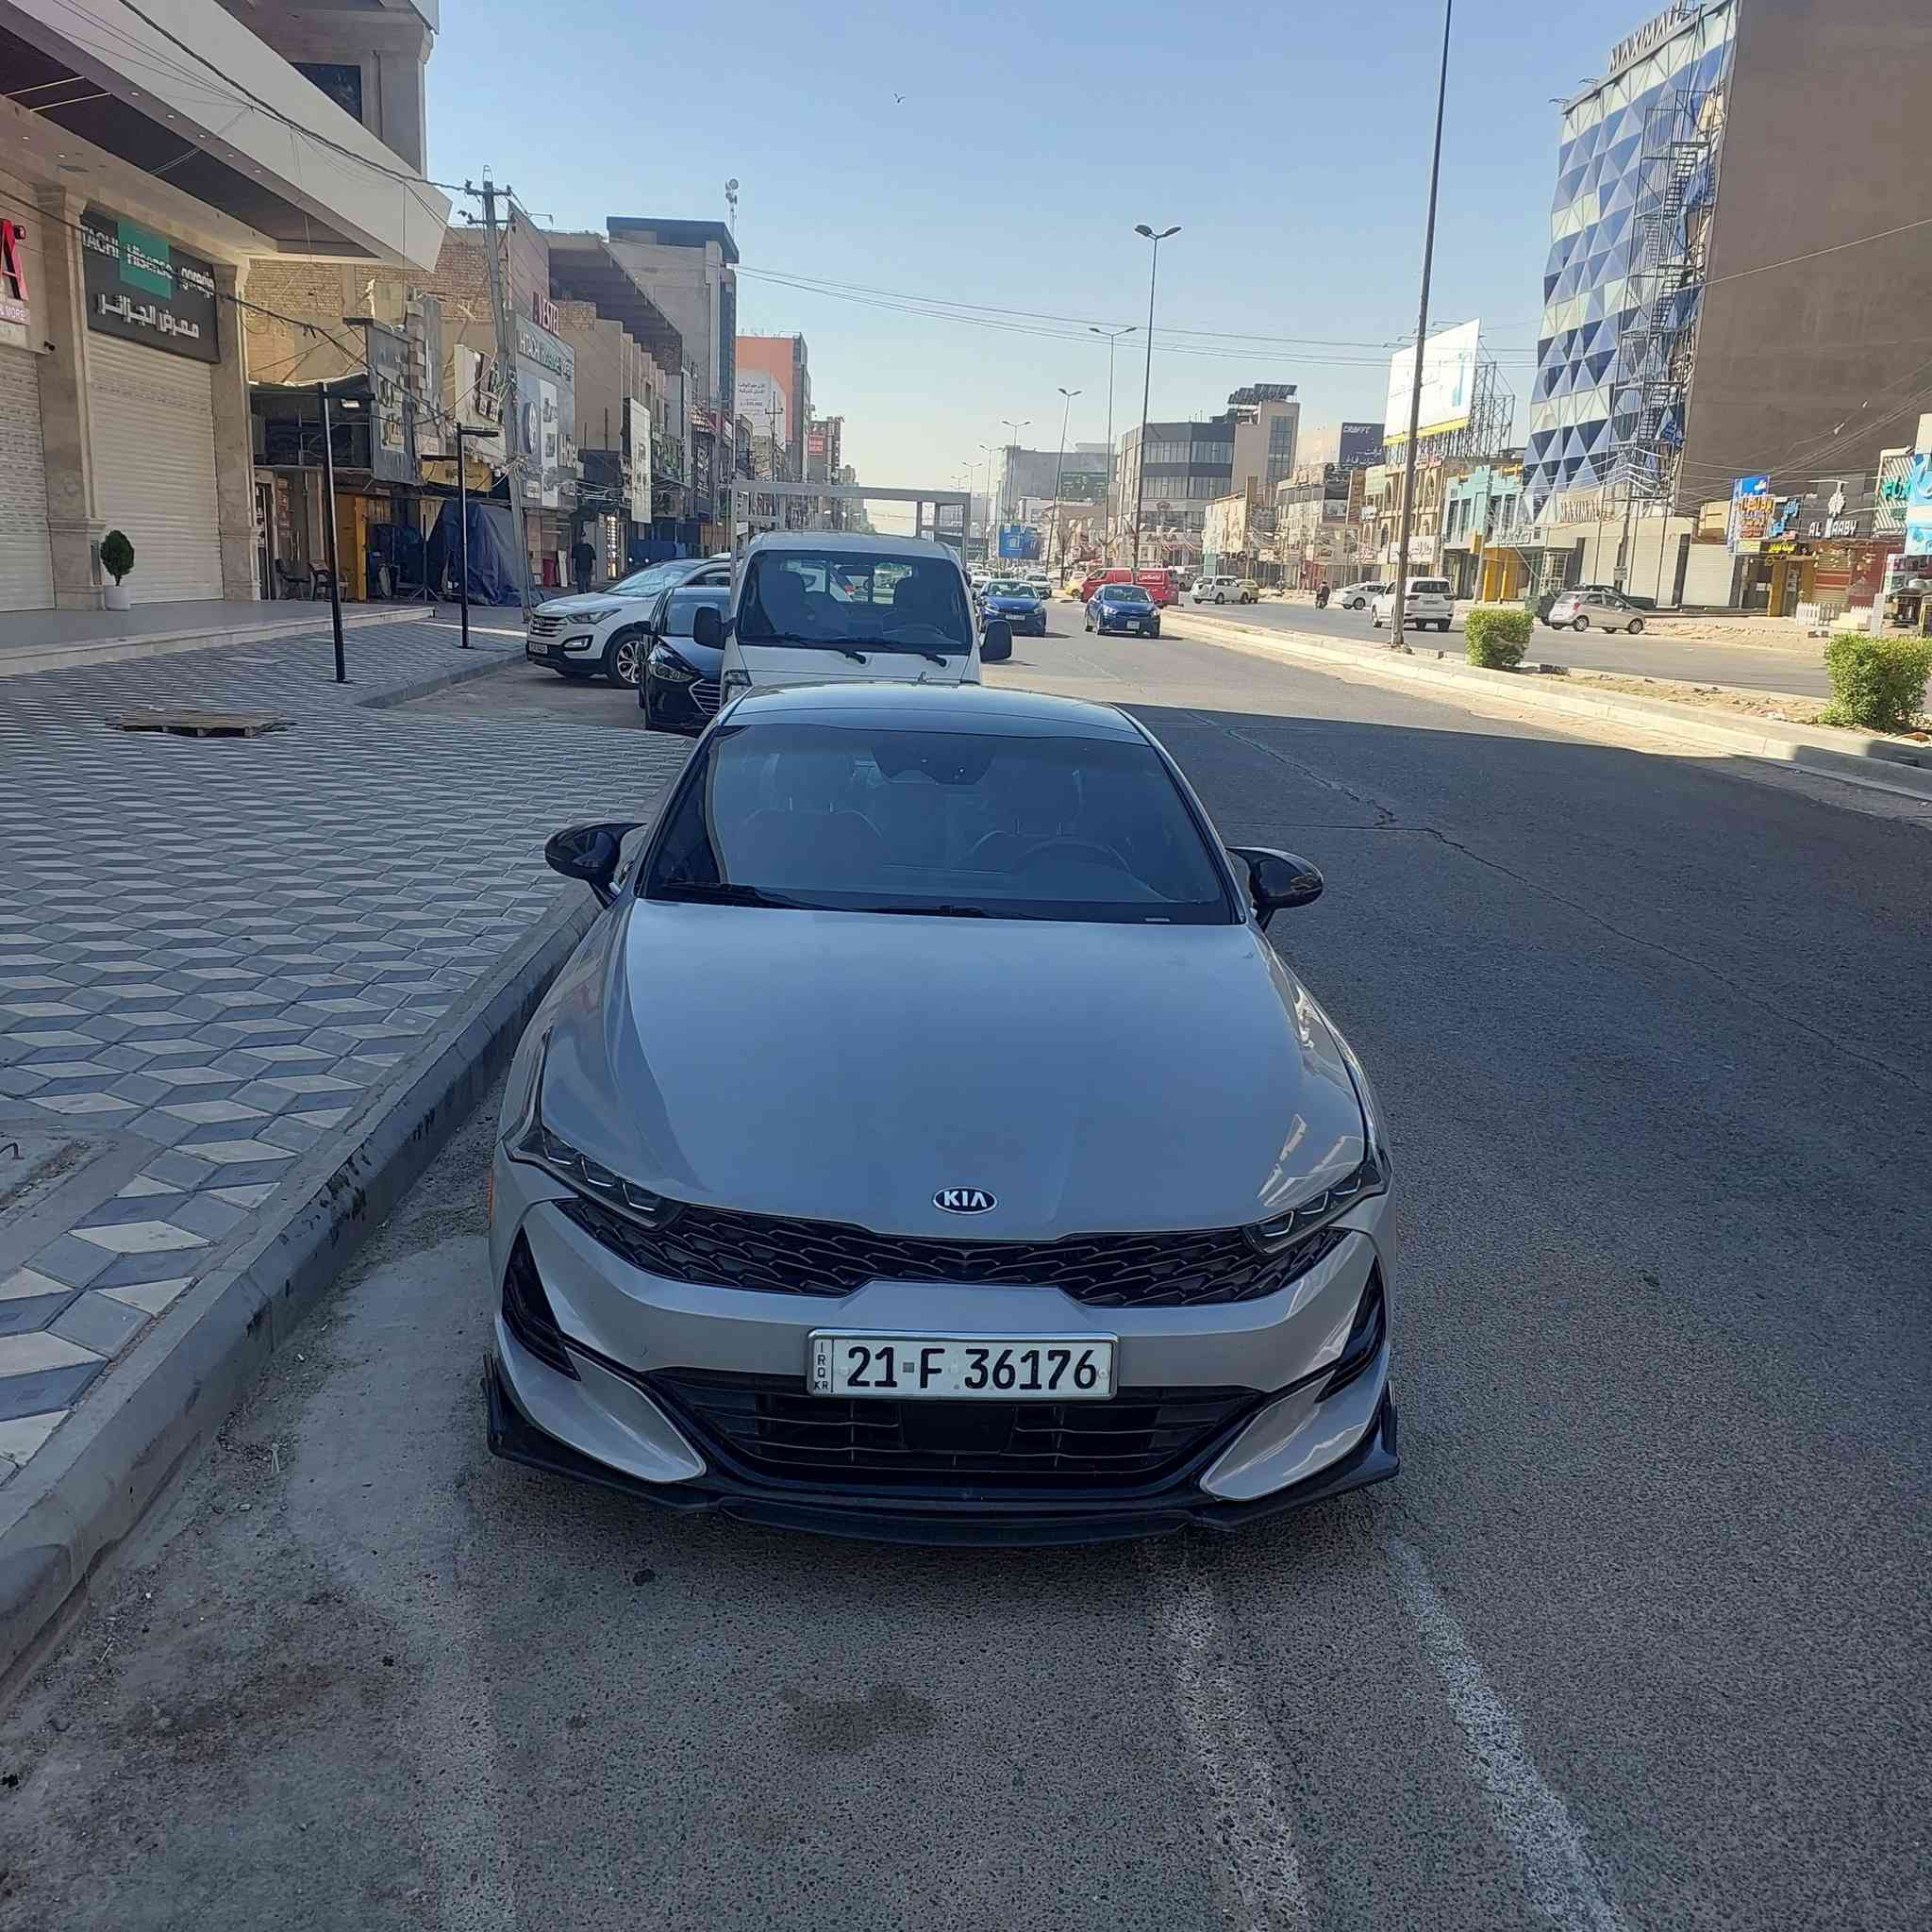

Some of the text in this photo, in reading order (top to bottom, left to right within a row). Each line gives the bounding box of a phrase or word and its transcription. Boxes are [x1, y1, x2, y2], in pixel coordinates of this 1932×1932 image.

[1808, 522, 1822, 537] AL
[943, 1191, 988, 1208] KIA
[847, 1346, 1097, 1391] 21 F 36176
[814, 1380, 828, 1391] KR
